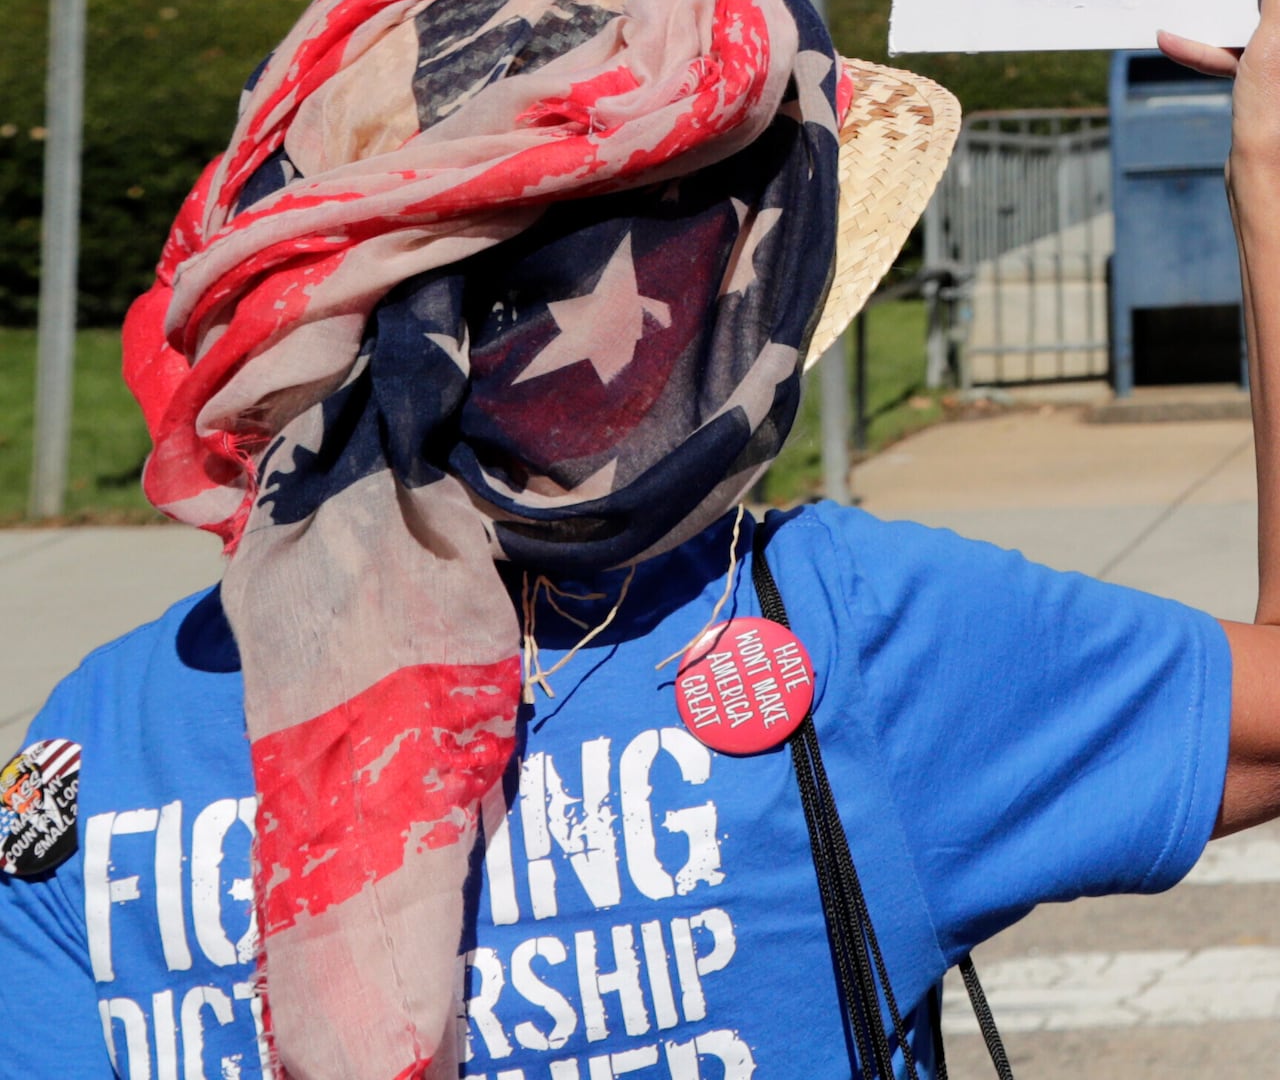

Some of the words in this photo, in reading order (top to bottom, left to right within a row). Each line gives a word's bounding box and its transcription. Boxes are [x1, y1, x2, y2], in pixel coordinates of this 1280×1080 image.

[706, 651, 754, 729] AMERICA
[773, 641, 810, 693] HATE
[680, 674, 722, 729] GREAT
[751, 676, 790, 729] MAKE
[9, 797, 45, 836] MAKE
[43, 774, 64, 798] MY
[11, 770, 43, 812] ASS
[56, 779, 79, 808] LOO
[83, 727, 728, 983] FIGING
